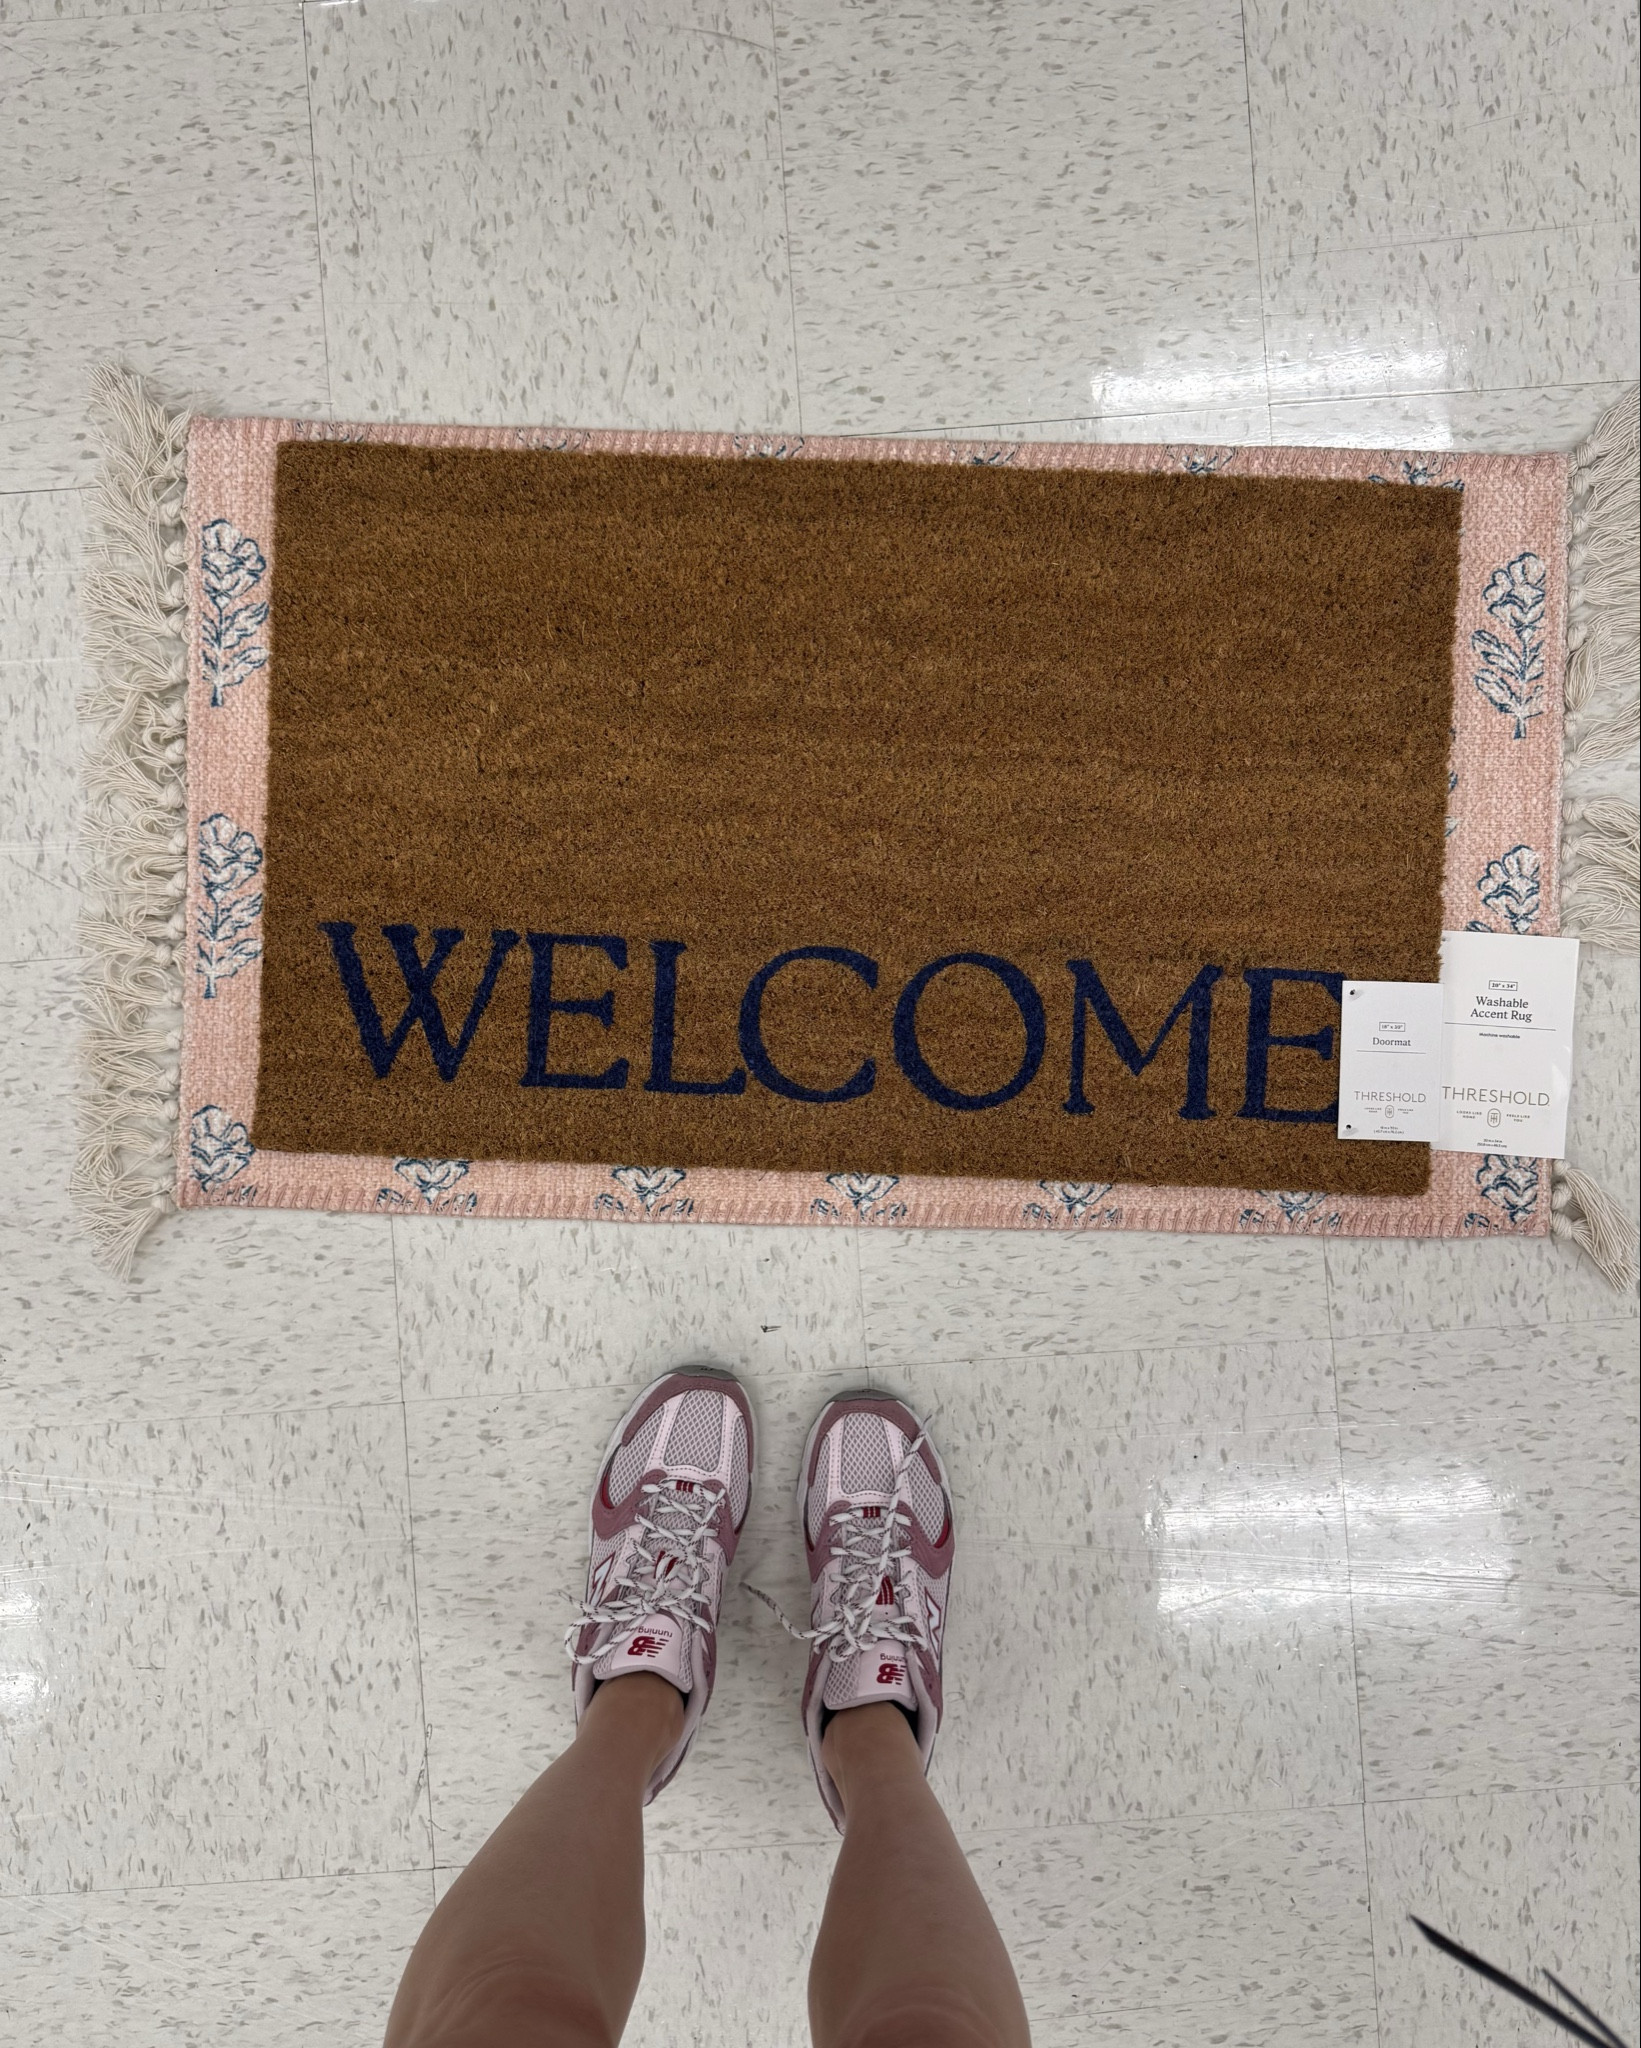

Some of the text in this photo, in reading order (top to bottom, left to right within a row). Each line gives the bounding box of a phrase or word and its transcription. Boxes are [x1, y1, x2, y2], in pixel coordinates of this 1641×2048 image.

[1476, 996, 1528, 1008] Washable
[1470, 1008, 1532, 1023] Accent Rug
[319, 922, 1343, 1125] WELCOME
[1372, 1037, 1411, 1046] Doormat
[1354, 1091, 1426, 1103] THRESHOLD
[1442, 1086, 1550, 1106] THRESHOLD
[638, 1626, 673, 1638] running
